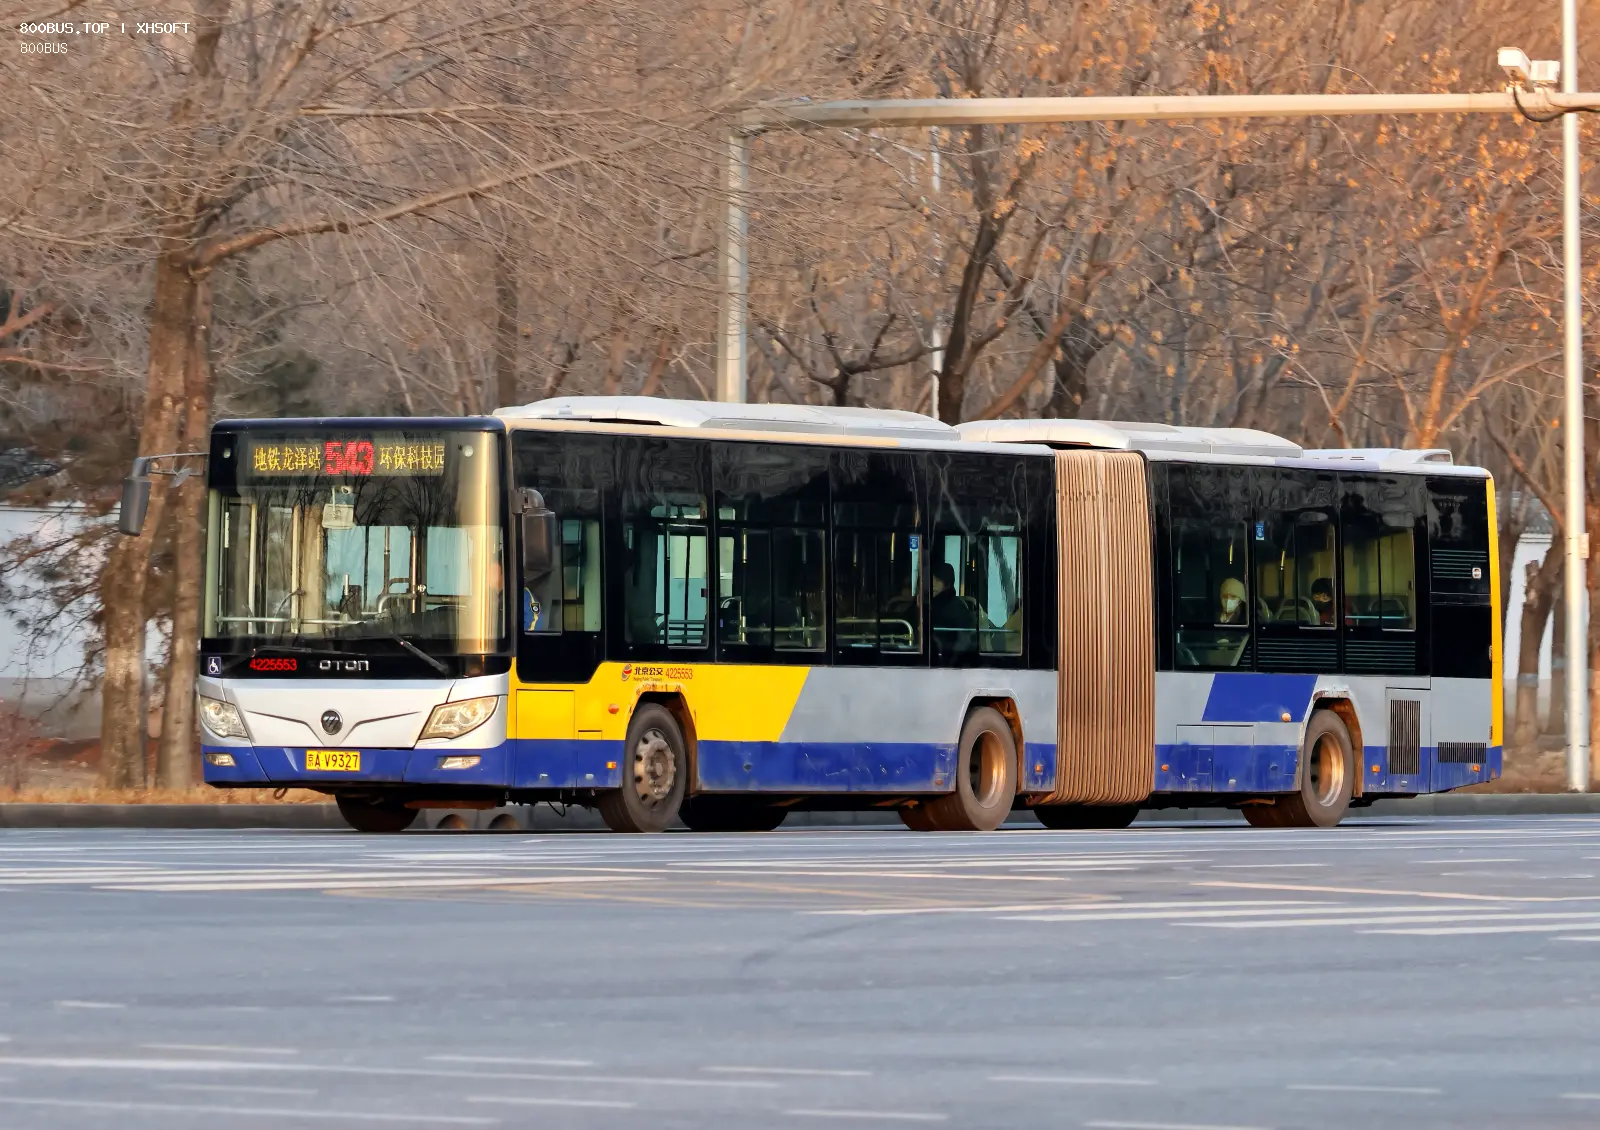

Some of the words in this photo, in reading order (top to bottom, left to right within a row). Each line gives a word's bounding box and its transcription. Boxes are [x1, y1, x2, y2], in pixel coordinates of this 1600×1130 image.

[253, 446, 321, 471] 地铁龙泽站
[325, 441, 375, 475] 543
[379, 445, 445, 471] 环保科技园
[250, 658, 298, 671] 4225553
[634, 666, 664, 676] 北京公交
[665, 667, 694, 680] 4225553
